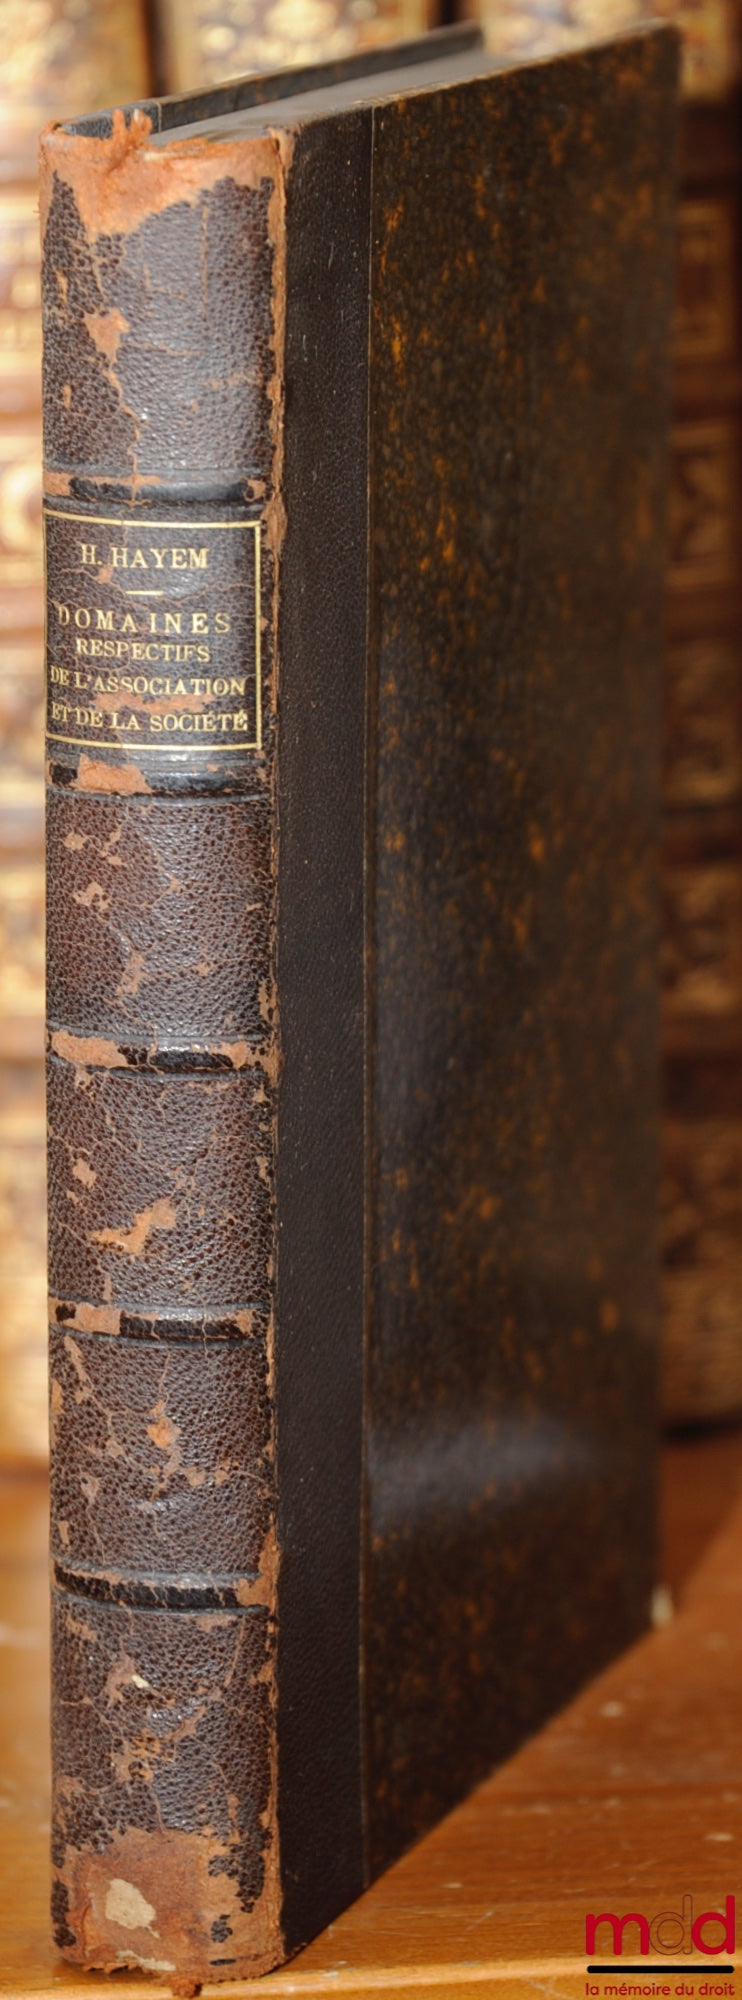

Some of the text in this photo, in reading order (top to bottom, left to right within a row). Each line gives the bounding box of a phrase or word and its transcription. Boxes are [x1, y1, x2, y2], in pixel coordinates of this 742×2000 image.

[80, 544, 210, 569] H. HAYEM
[58, 606, 231, 634] DOMAINES
[76, 638, 211, 663] RESPECTIFS
[50, 665, 246, 696] DE L'ASSOCIATION
[51, 701, 248, 732] ET DE LA SOCIÉTÉ
